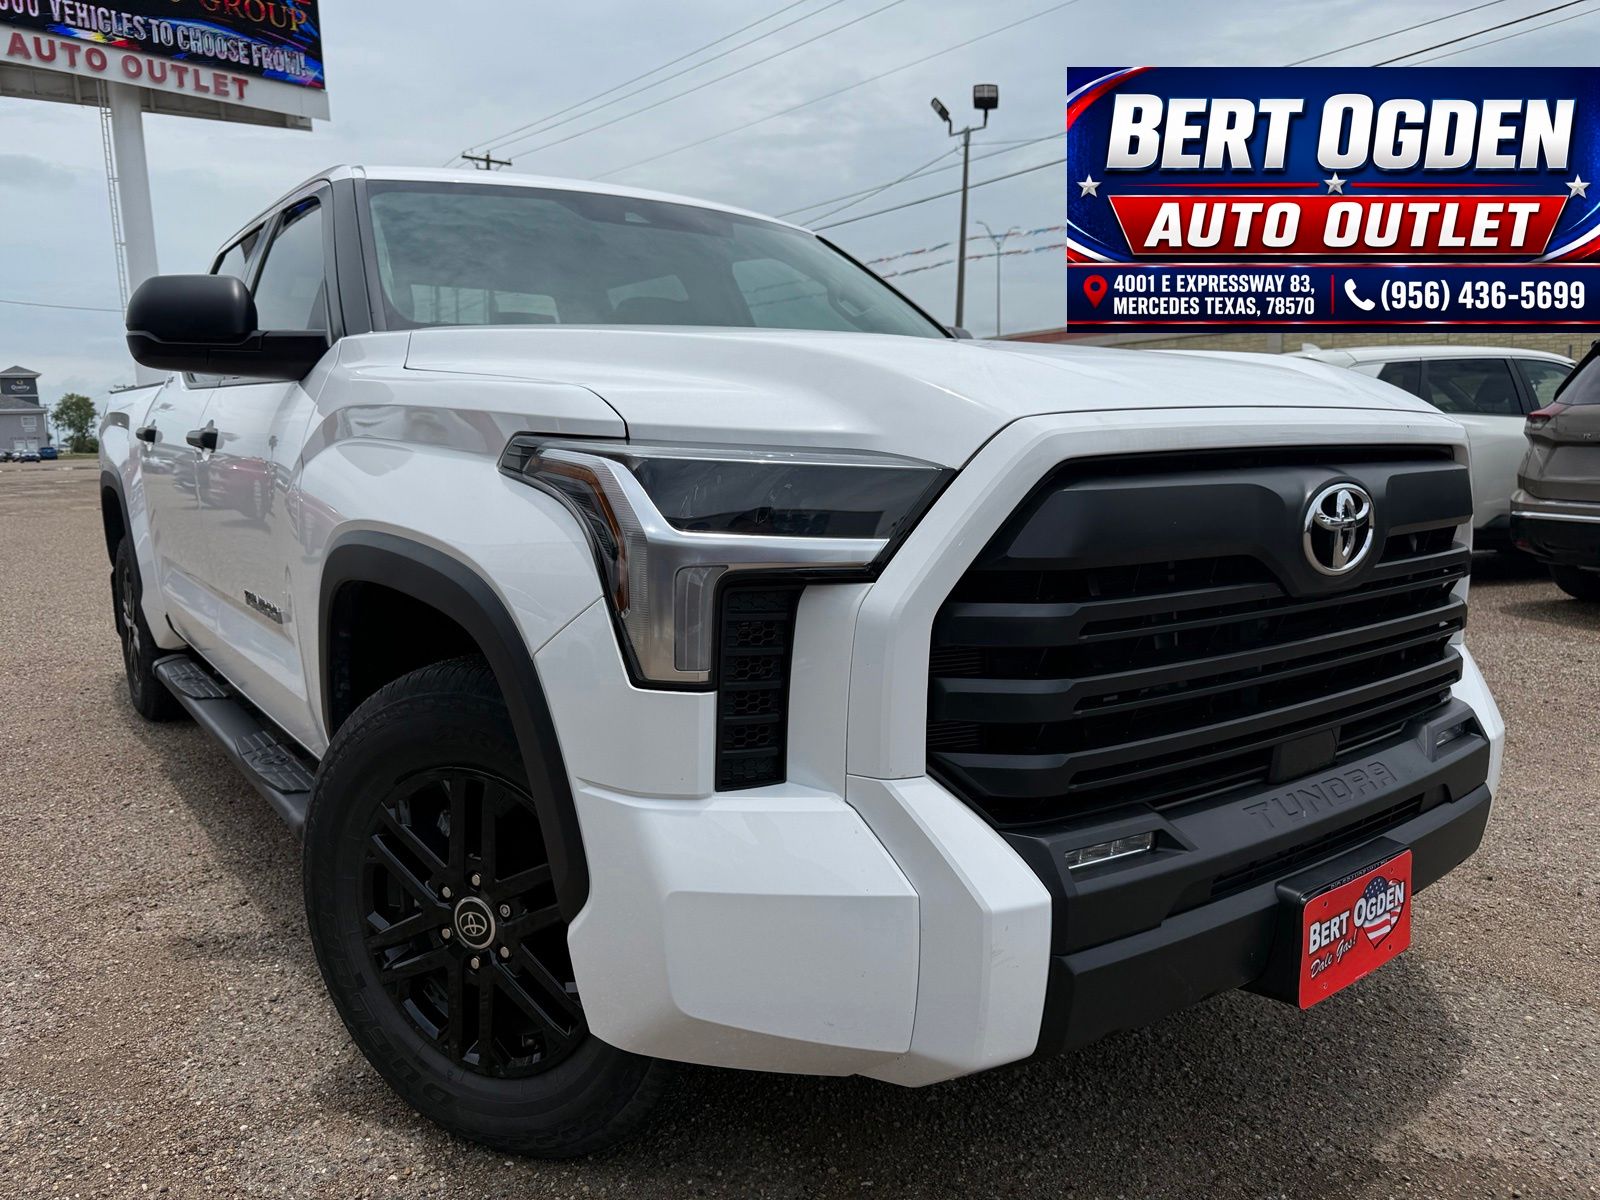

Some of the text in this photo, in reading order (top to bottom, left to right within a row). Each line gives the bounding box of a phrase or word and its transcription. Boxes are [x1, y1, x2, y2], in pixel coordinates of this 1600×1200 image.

[7, 32, 249, 99] AUTO OUTLET
[50, 0, 145, 40] VEHICLES
[148, 18, 174, 46] TO
[177, 25, 250, 65] CHOOSE
[1242, 761, 1398, 829] TUNDRA
[1308, 881, 1405, 955] BERT OGDEN
